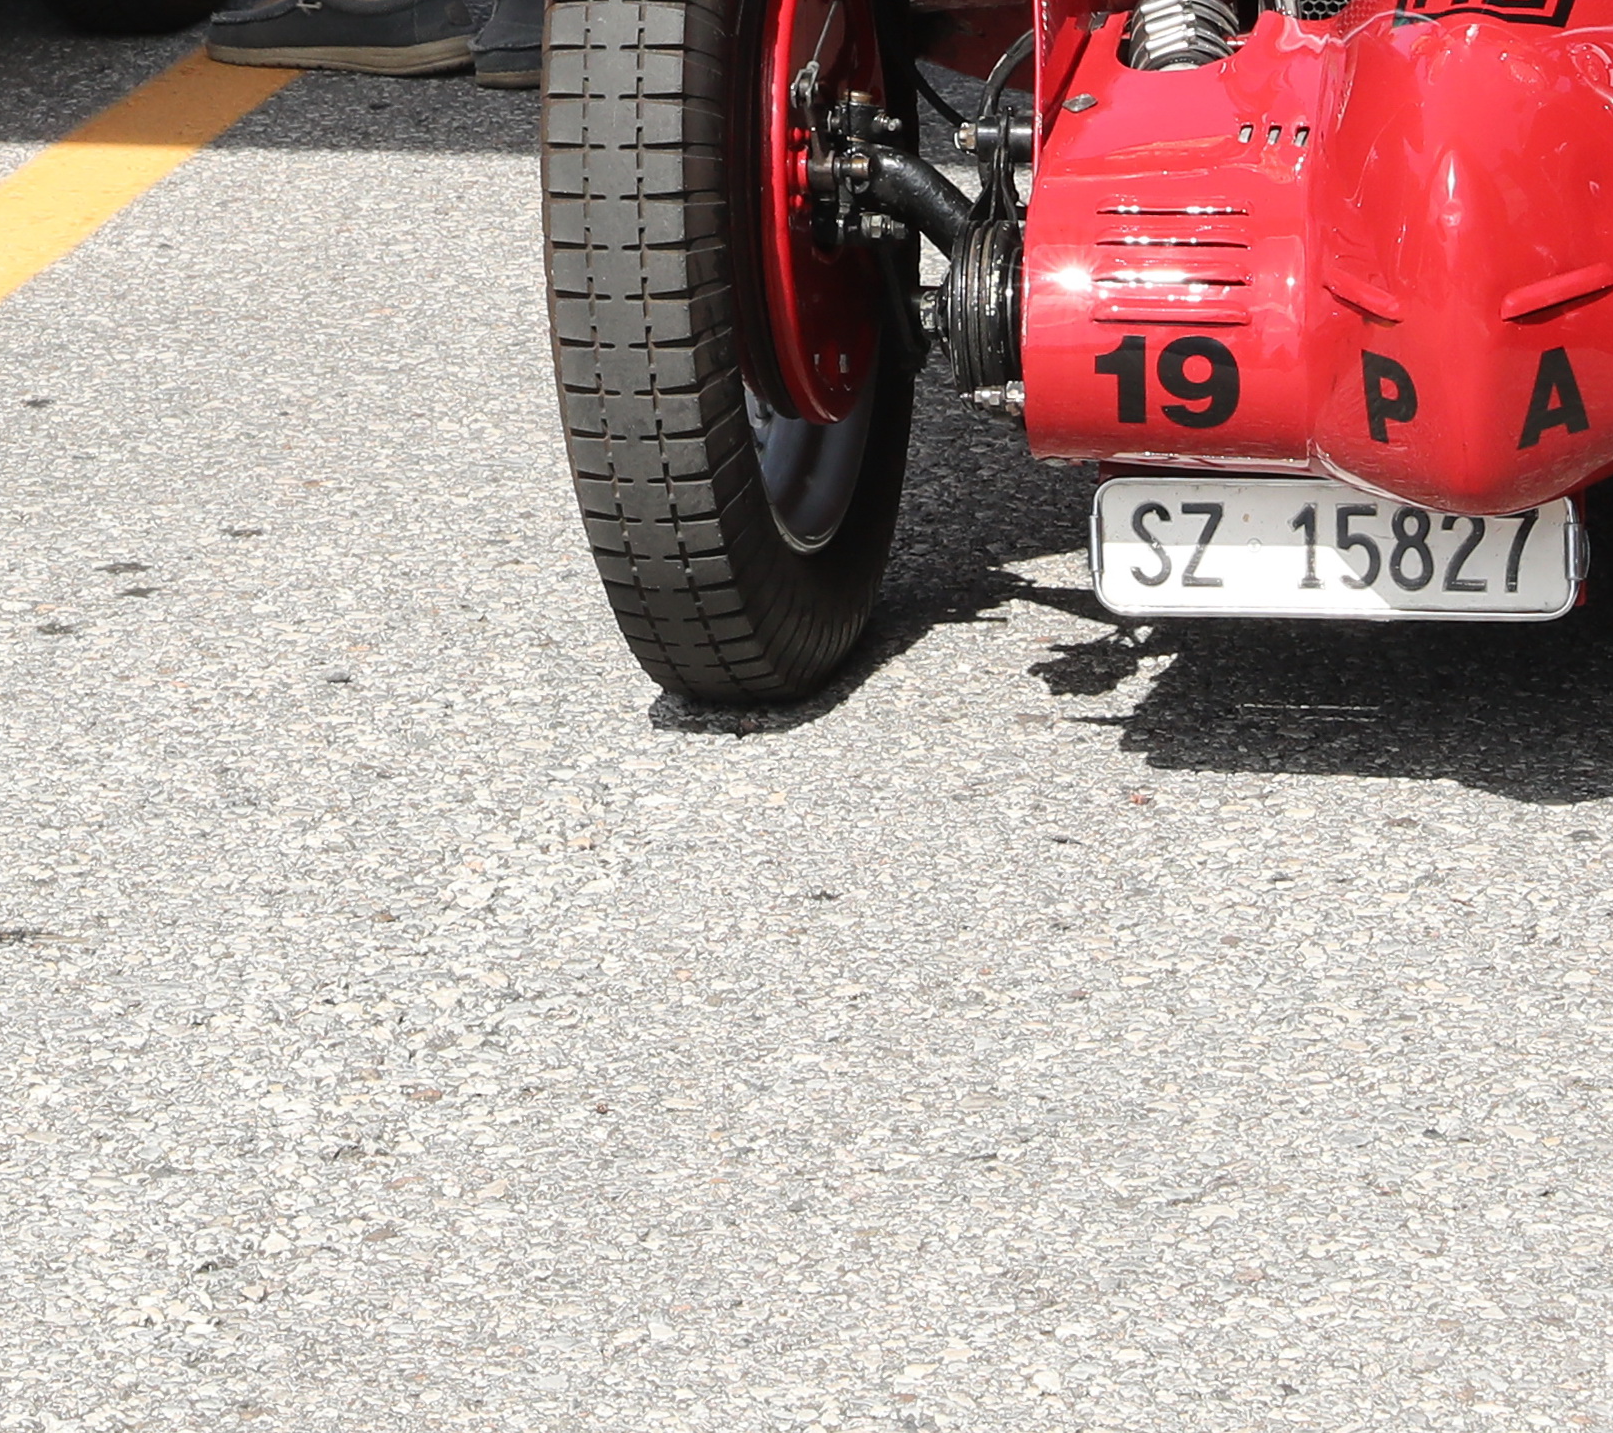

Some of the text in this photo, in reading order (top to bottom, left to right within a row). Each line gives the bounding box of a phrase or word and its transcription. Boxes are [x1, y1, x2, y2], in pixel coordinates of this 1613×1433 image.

[1093, 334, 1241, 429] 19
[1360, 348, 1420, 445] P
[1517, 344, 1590, 451] A
[1129, 499, 1541, 595] SZ 15827
